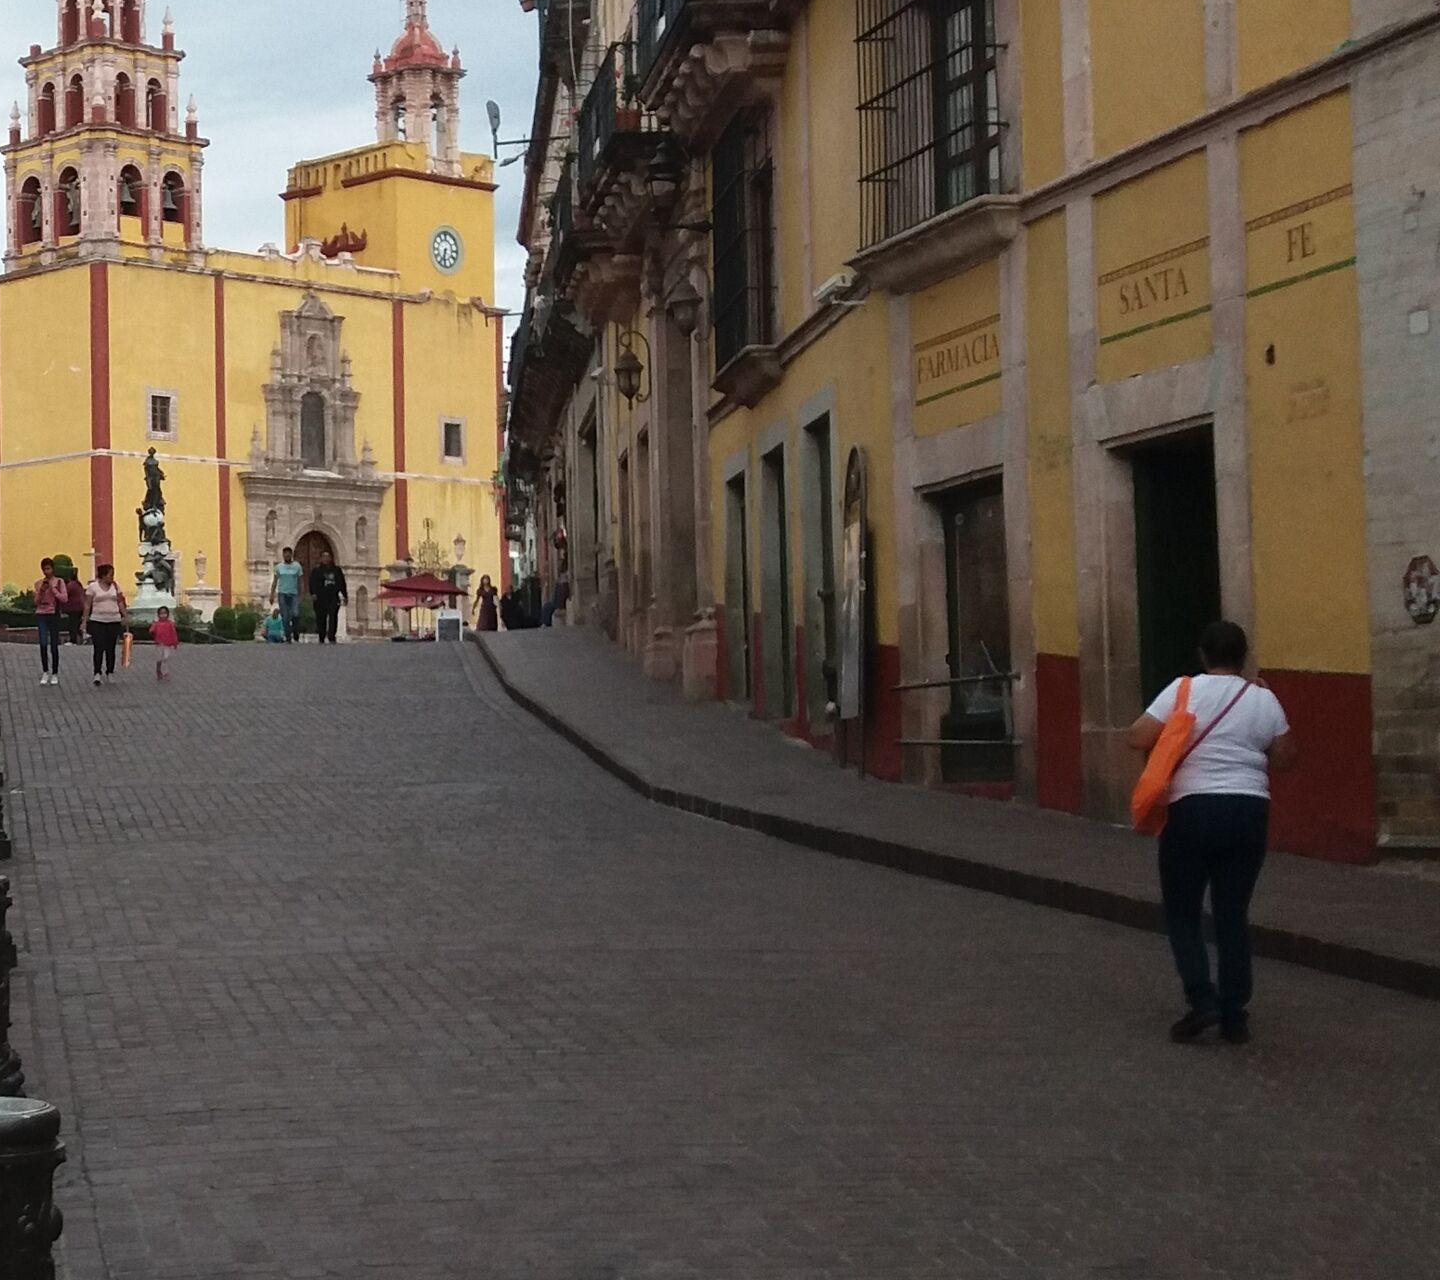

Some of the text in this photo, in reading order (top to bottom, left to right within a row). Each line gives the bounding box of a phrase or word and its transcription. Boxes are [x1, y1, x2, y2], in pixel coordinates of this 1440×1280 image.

[917, 222, 1316, 384] FARMACIA SANTA FE
